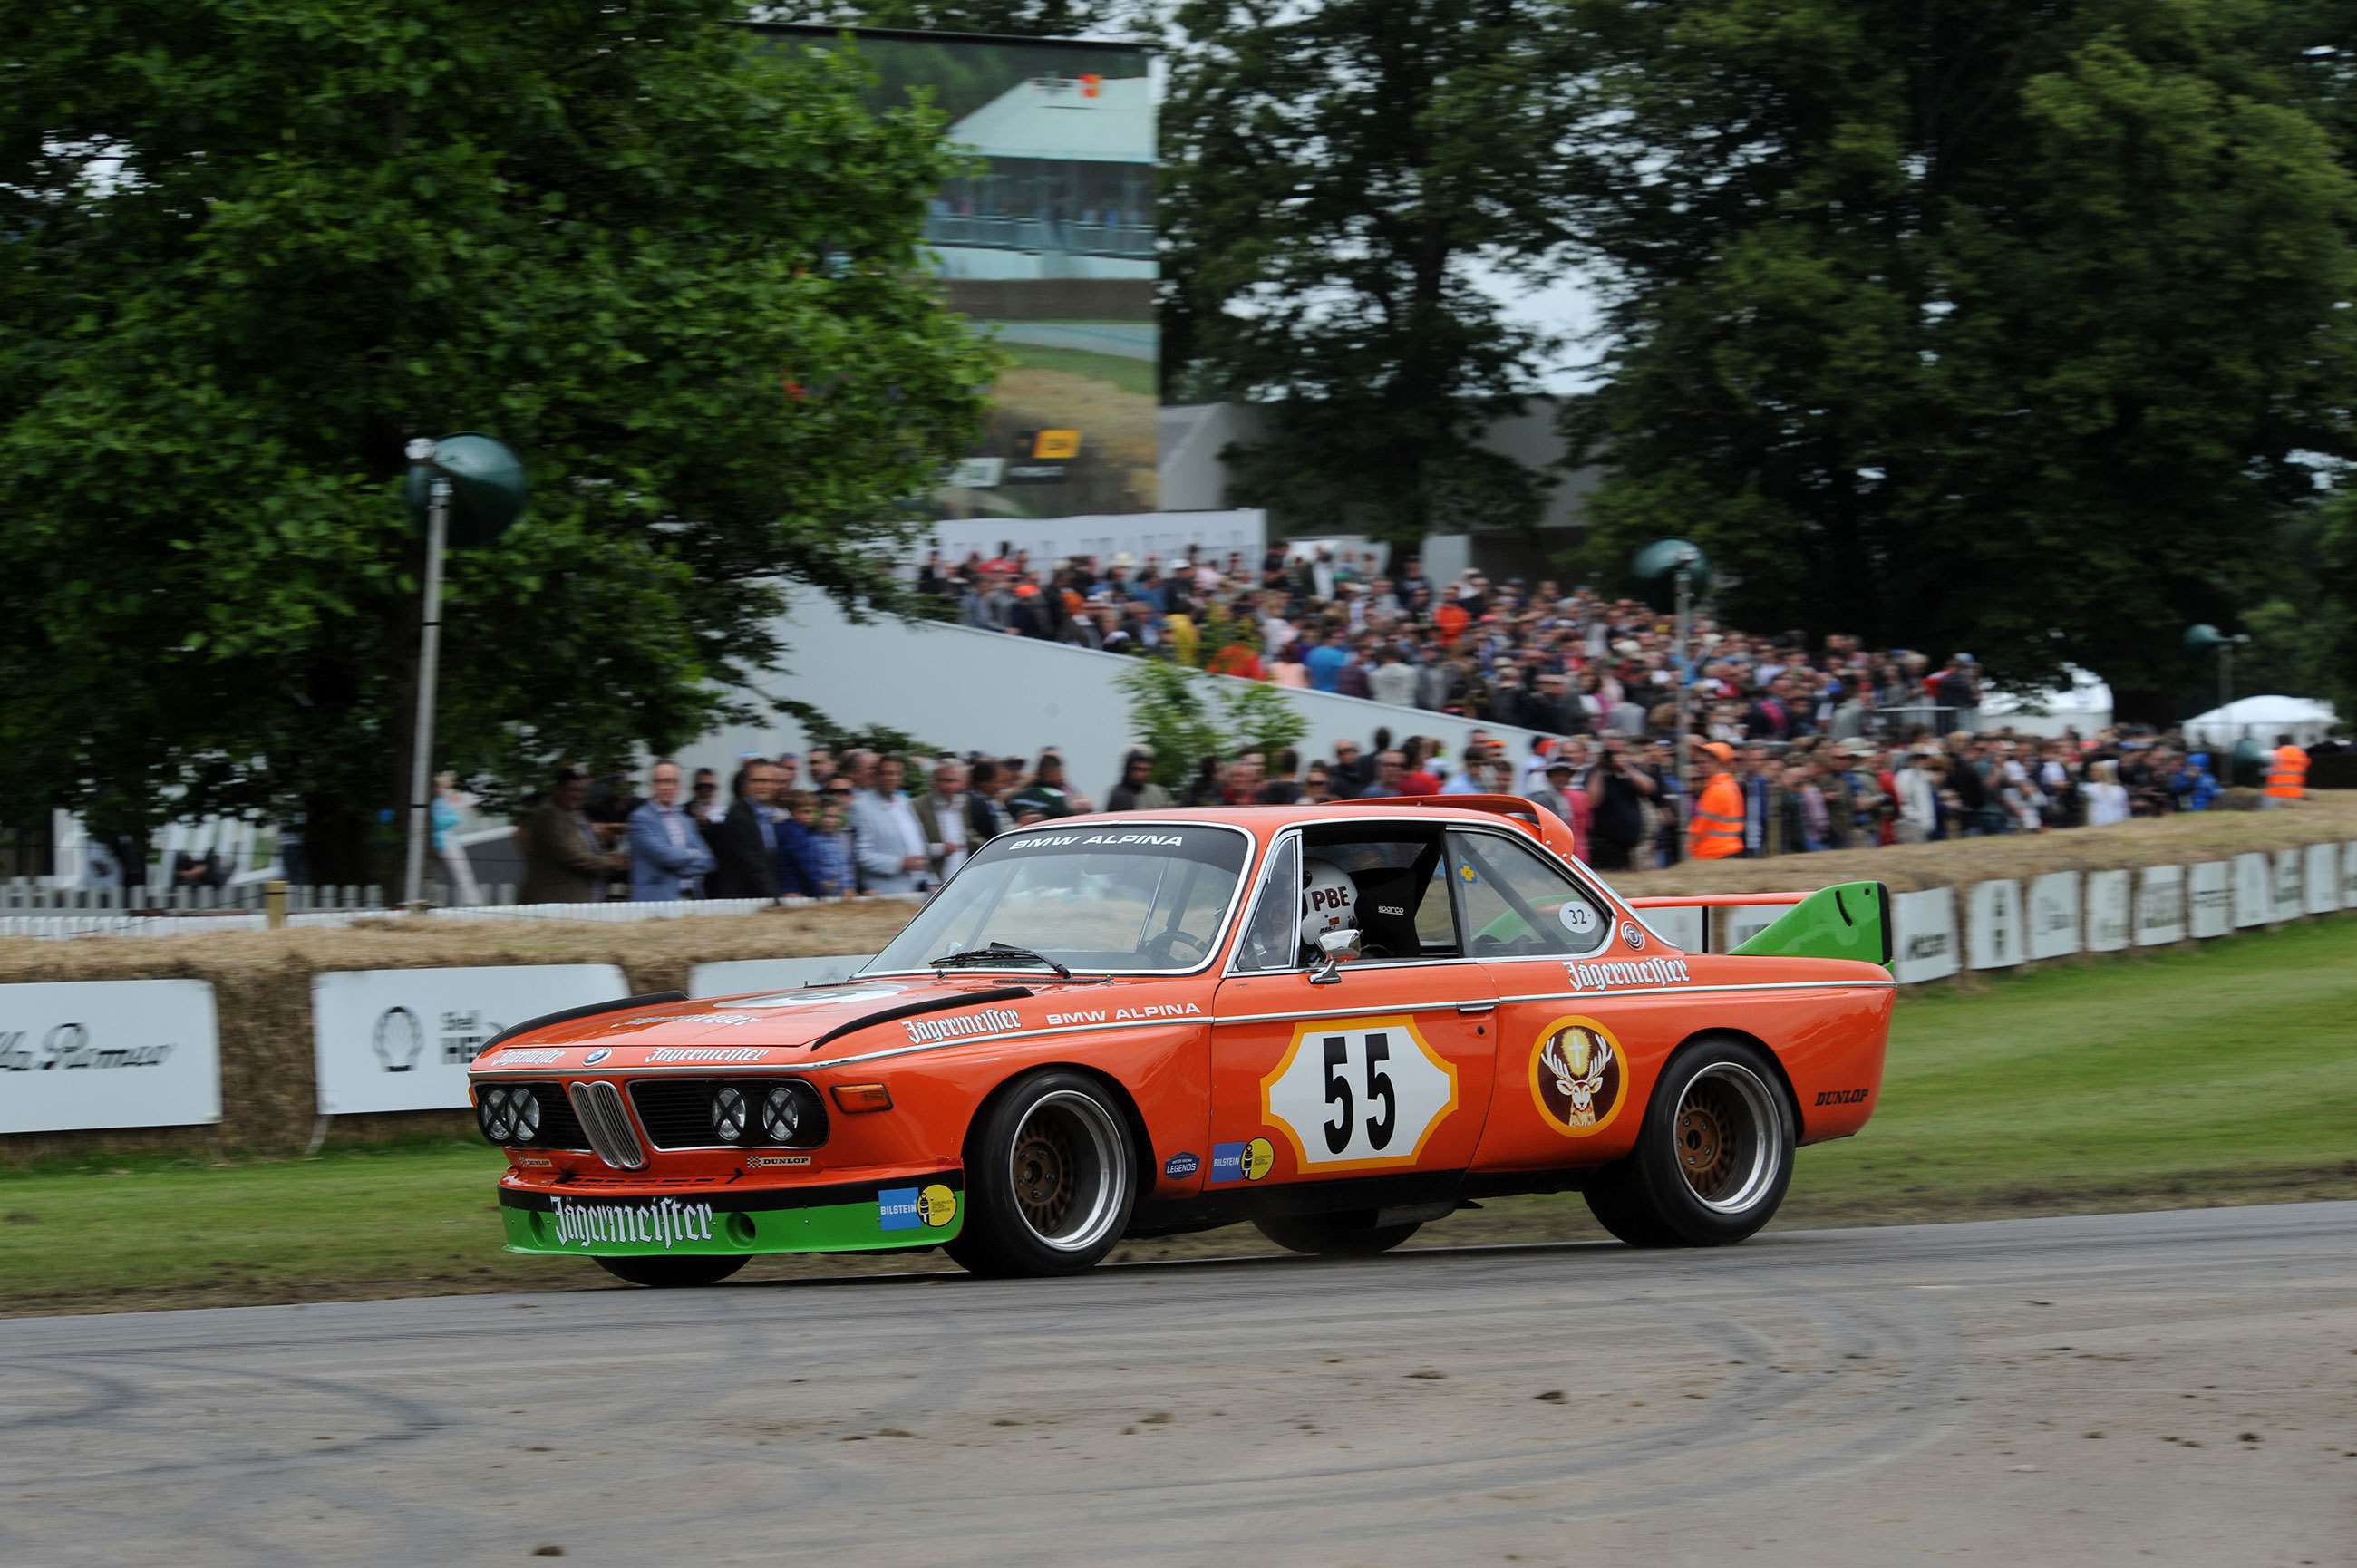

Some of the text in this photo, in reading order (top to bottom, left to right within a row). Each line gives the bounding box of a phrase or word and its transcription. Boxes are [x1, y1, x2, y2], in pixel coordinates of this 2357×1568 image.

[1009, 835, 1183, 850] BMW ALPINA
[1311, 886, 1350, 912] PBE
[1568, 909, 1587, 925] 32
[1562, 957, 1691, 992] Jägermeister
[1046, 1002, 1202, 1025] BMW ALPINA
[901, 1009, 1022, 1045] Jägermeister
[645, 1047, 769, 1063] Jägermeister
[1323, 1032, 1396, 1155] 55
[1814, 1089, 1869, 1107] DUNLOP
[1166, 1163, 1197, 1174] LEGENDS
[1213, 1158, 1240, 1167] BILSTEIN
[880, 1204, 917, 1215] BILSTEIN
[549, 1195, 713, 1250] Jägermeister
